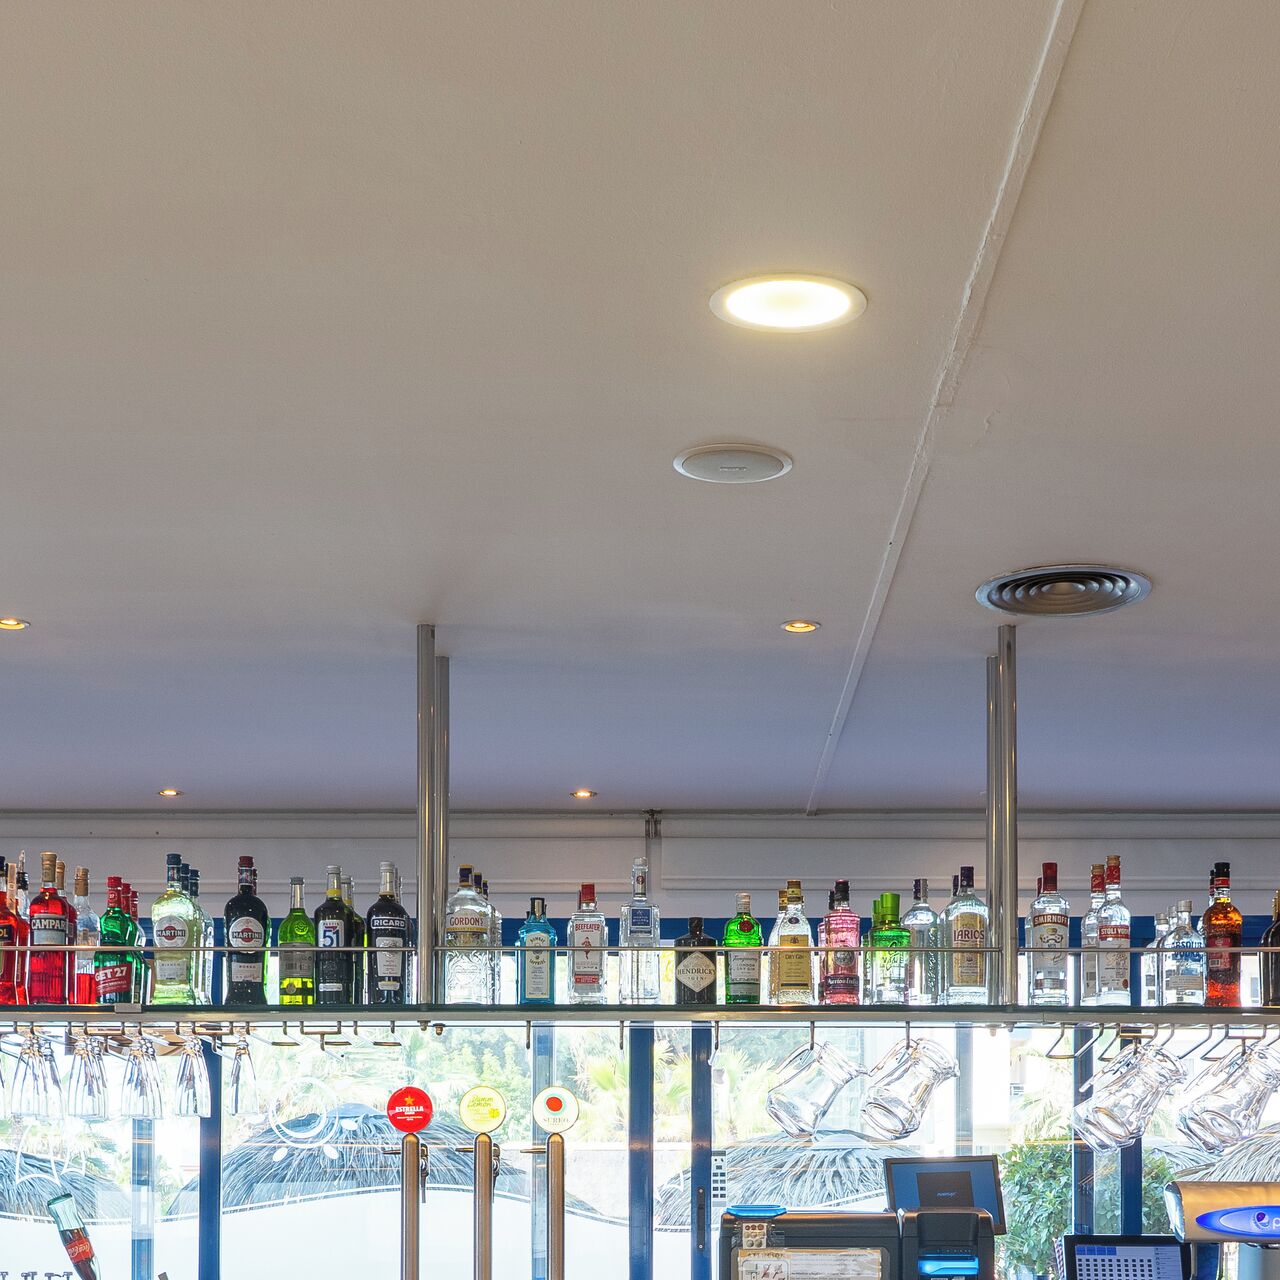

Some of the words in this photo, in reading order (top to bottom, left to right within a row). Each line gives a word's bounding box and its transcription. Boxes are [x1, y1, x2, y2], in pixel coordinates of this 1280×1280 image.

[373, 919, 406, 928] RICARD
[574, 923, 601, 932] BEEFEATER
[156, 929, 186, 937] MARTINI
[231, 931, 262, 939] MARTINI
[953, 929, 985, 942] LARIOS
[1100, 927, 1117, 936] STOLI
[322, 927, 340, 947] 51
[94, 968, 113, 982] GET
[113, 966, 128, 978] 27
[395, 1105, 424, 1113] ESTRELLA
